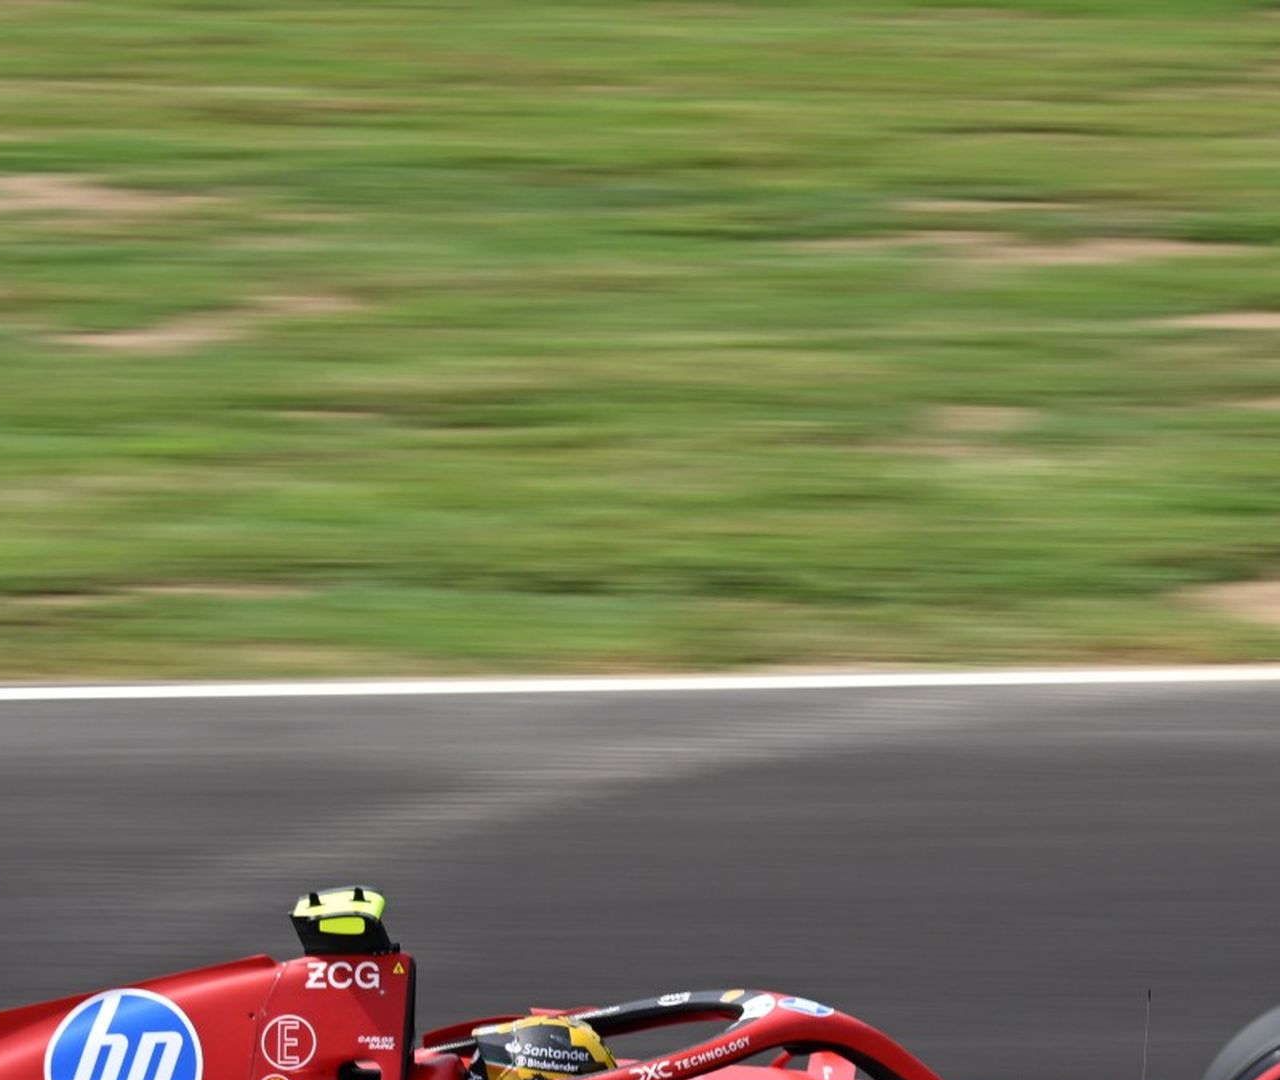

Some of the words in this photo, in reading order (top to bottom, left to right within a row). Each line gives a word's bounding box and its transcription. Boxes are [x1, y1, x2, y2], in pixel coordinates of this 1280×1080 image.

[305, 961, 381, 989] ZCG
[522, 1043, 590, 1062] Santander
[674, 1035, 751, 1071] TECHNOLOGY
